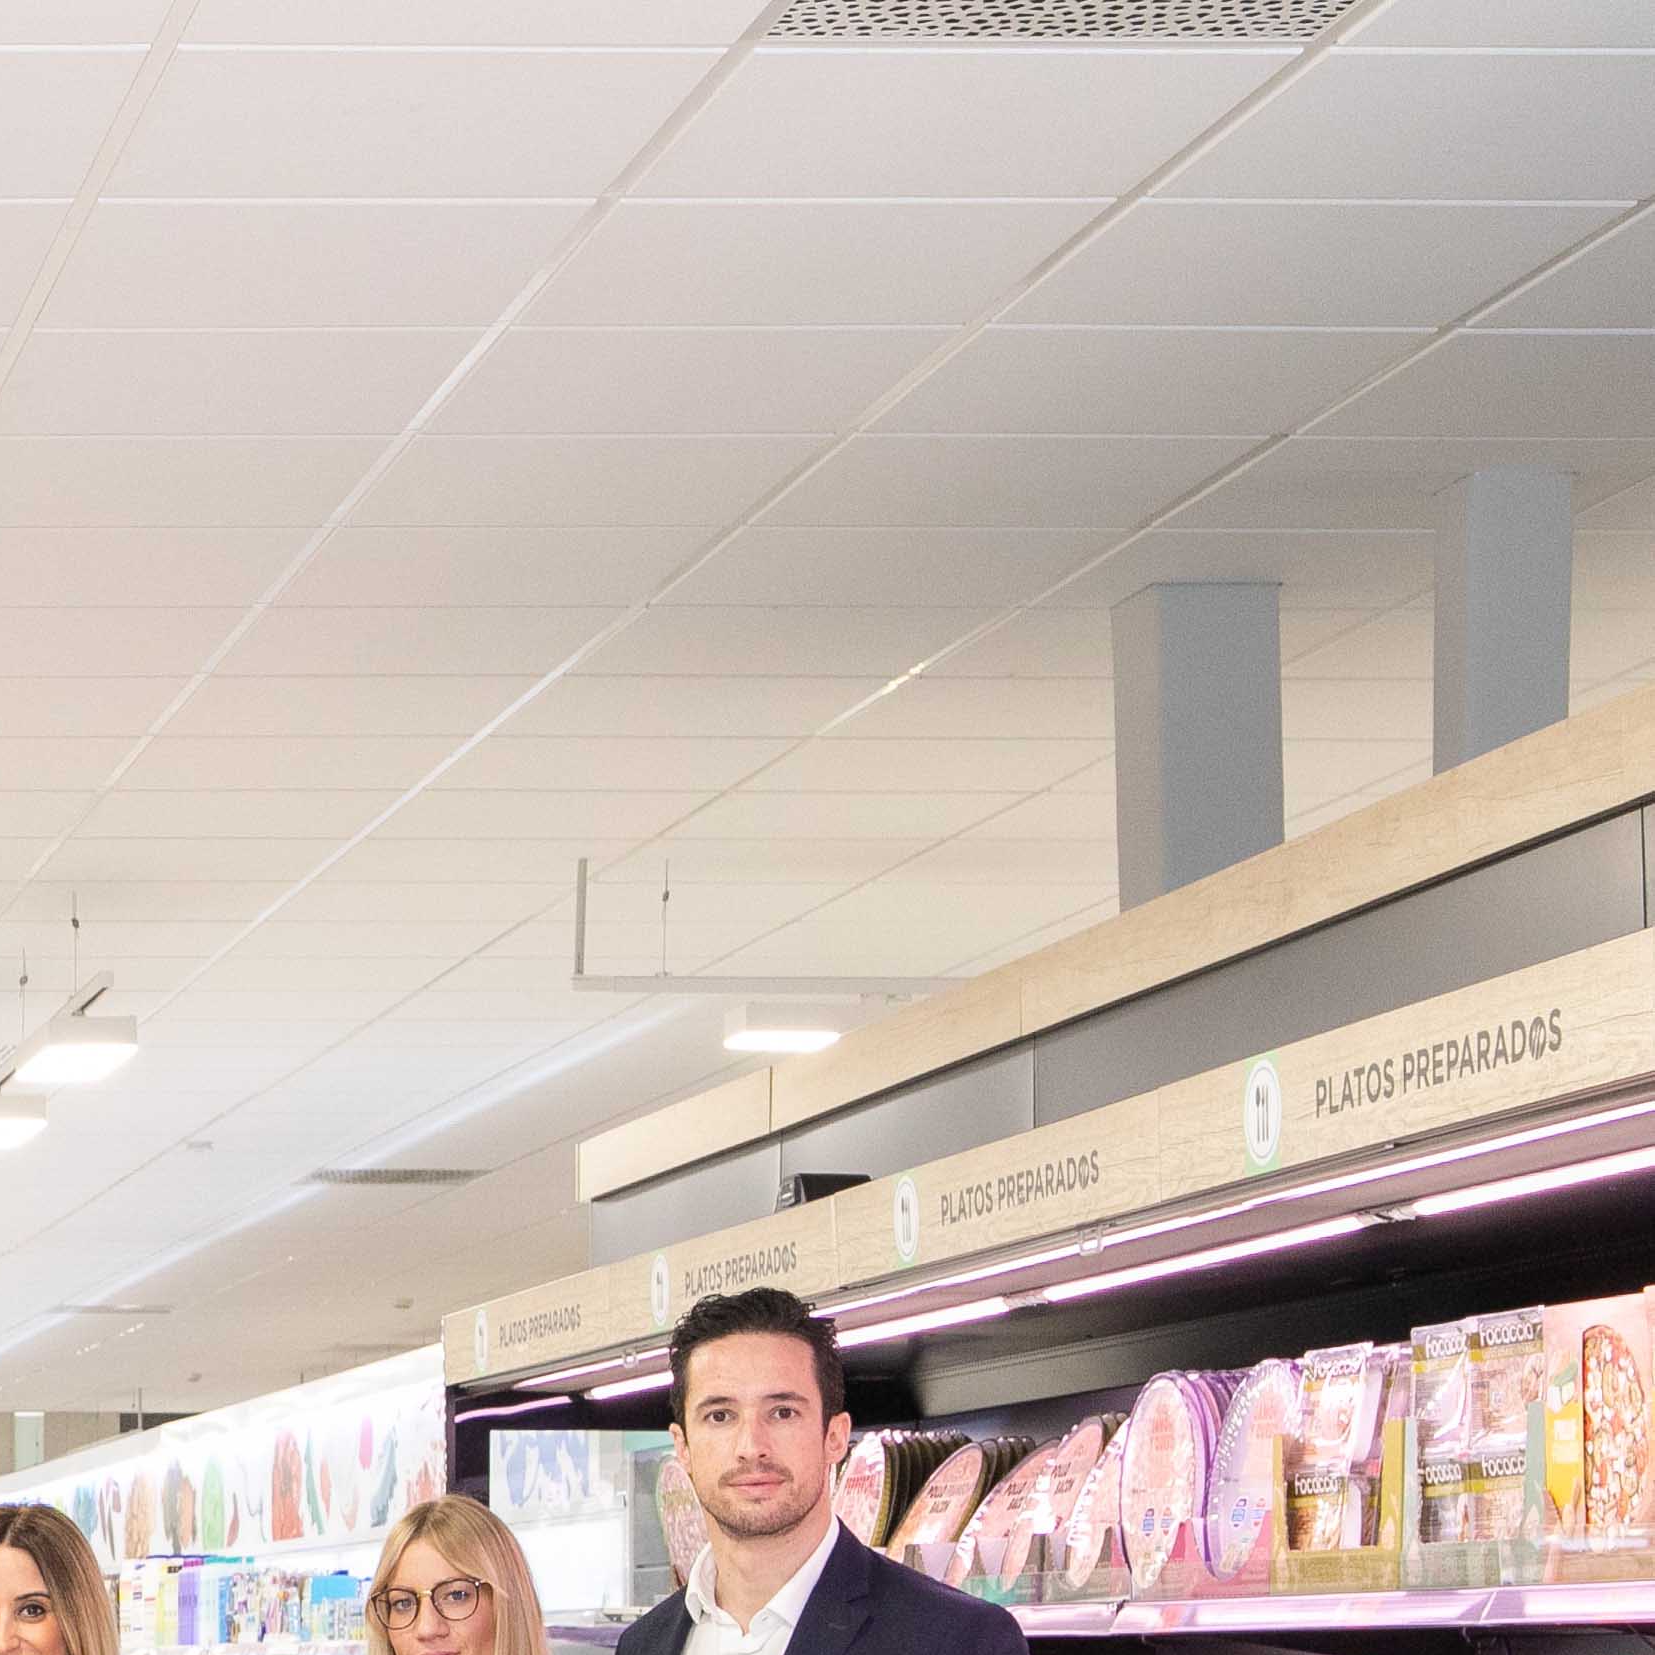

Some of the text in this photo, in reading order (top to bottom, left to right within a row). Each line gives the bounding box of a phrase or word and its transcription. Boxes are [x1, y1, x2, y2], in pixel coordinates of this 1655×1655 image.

[1314, 1009, 1562, 1119] PLATOS PREPARADOS
[939, 1150, 1099, 1227] PLATOS PREPARADOS
[684, 1241, 798, 1298] PLATOS PREPARADOS
[498, 1304, 581, 1349] PLATOS PREPARADOS
[1479, 1321, 1534, 1346] focaccia
